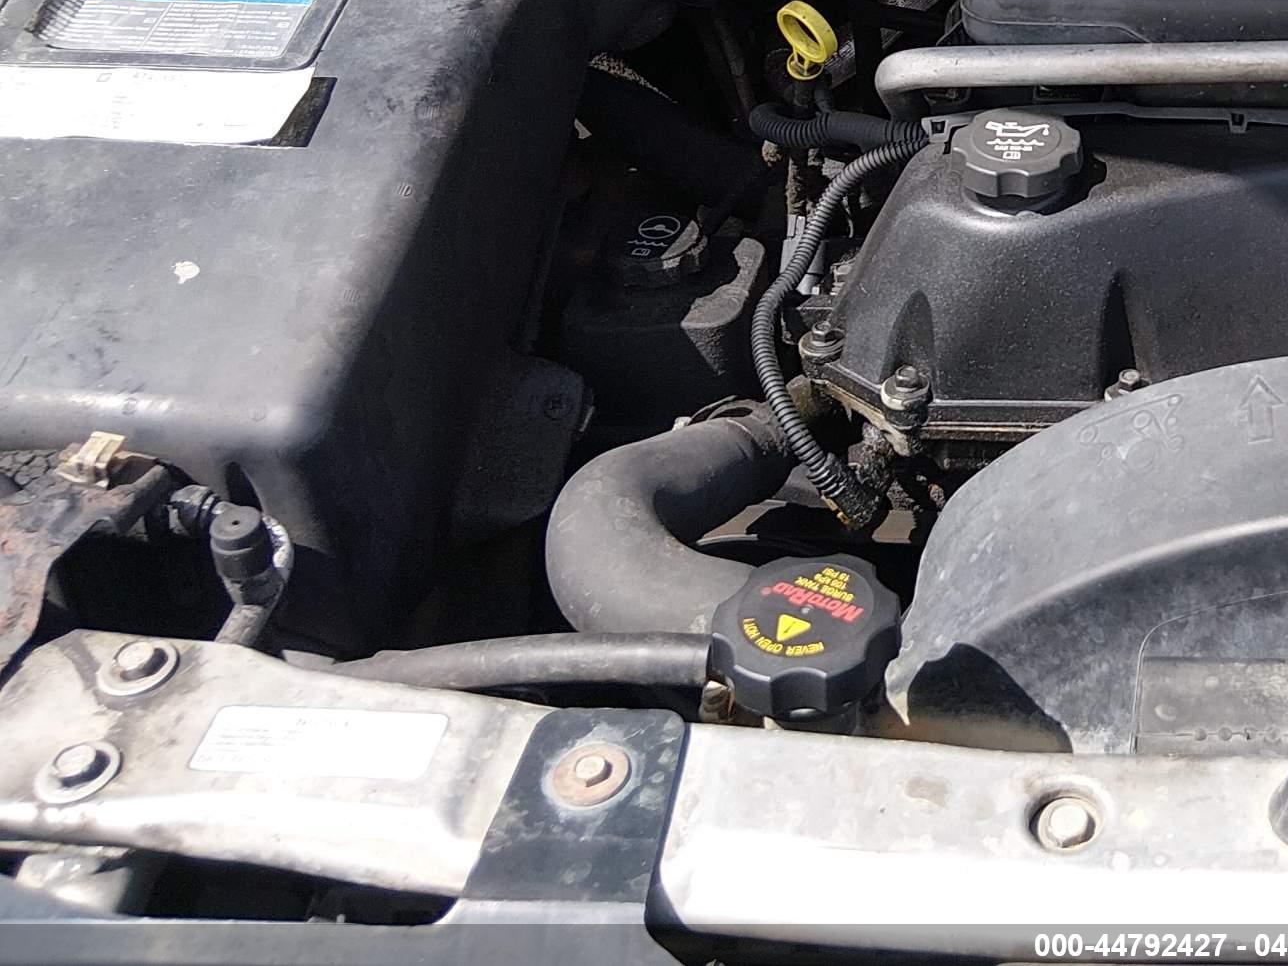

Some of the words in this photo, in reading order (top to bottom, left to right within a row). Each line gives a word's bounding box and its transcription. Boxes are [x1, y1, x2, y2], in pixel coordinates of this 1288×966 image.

[822, 567, 840, 579] PSI
[795, 577, 820, 591] TANK
[820, 585, 854, 602] SURGE
[754, 636, 783, 654] OPEN
[785, 641, 825, 656] NEVER
